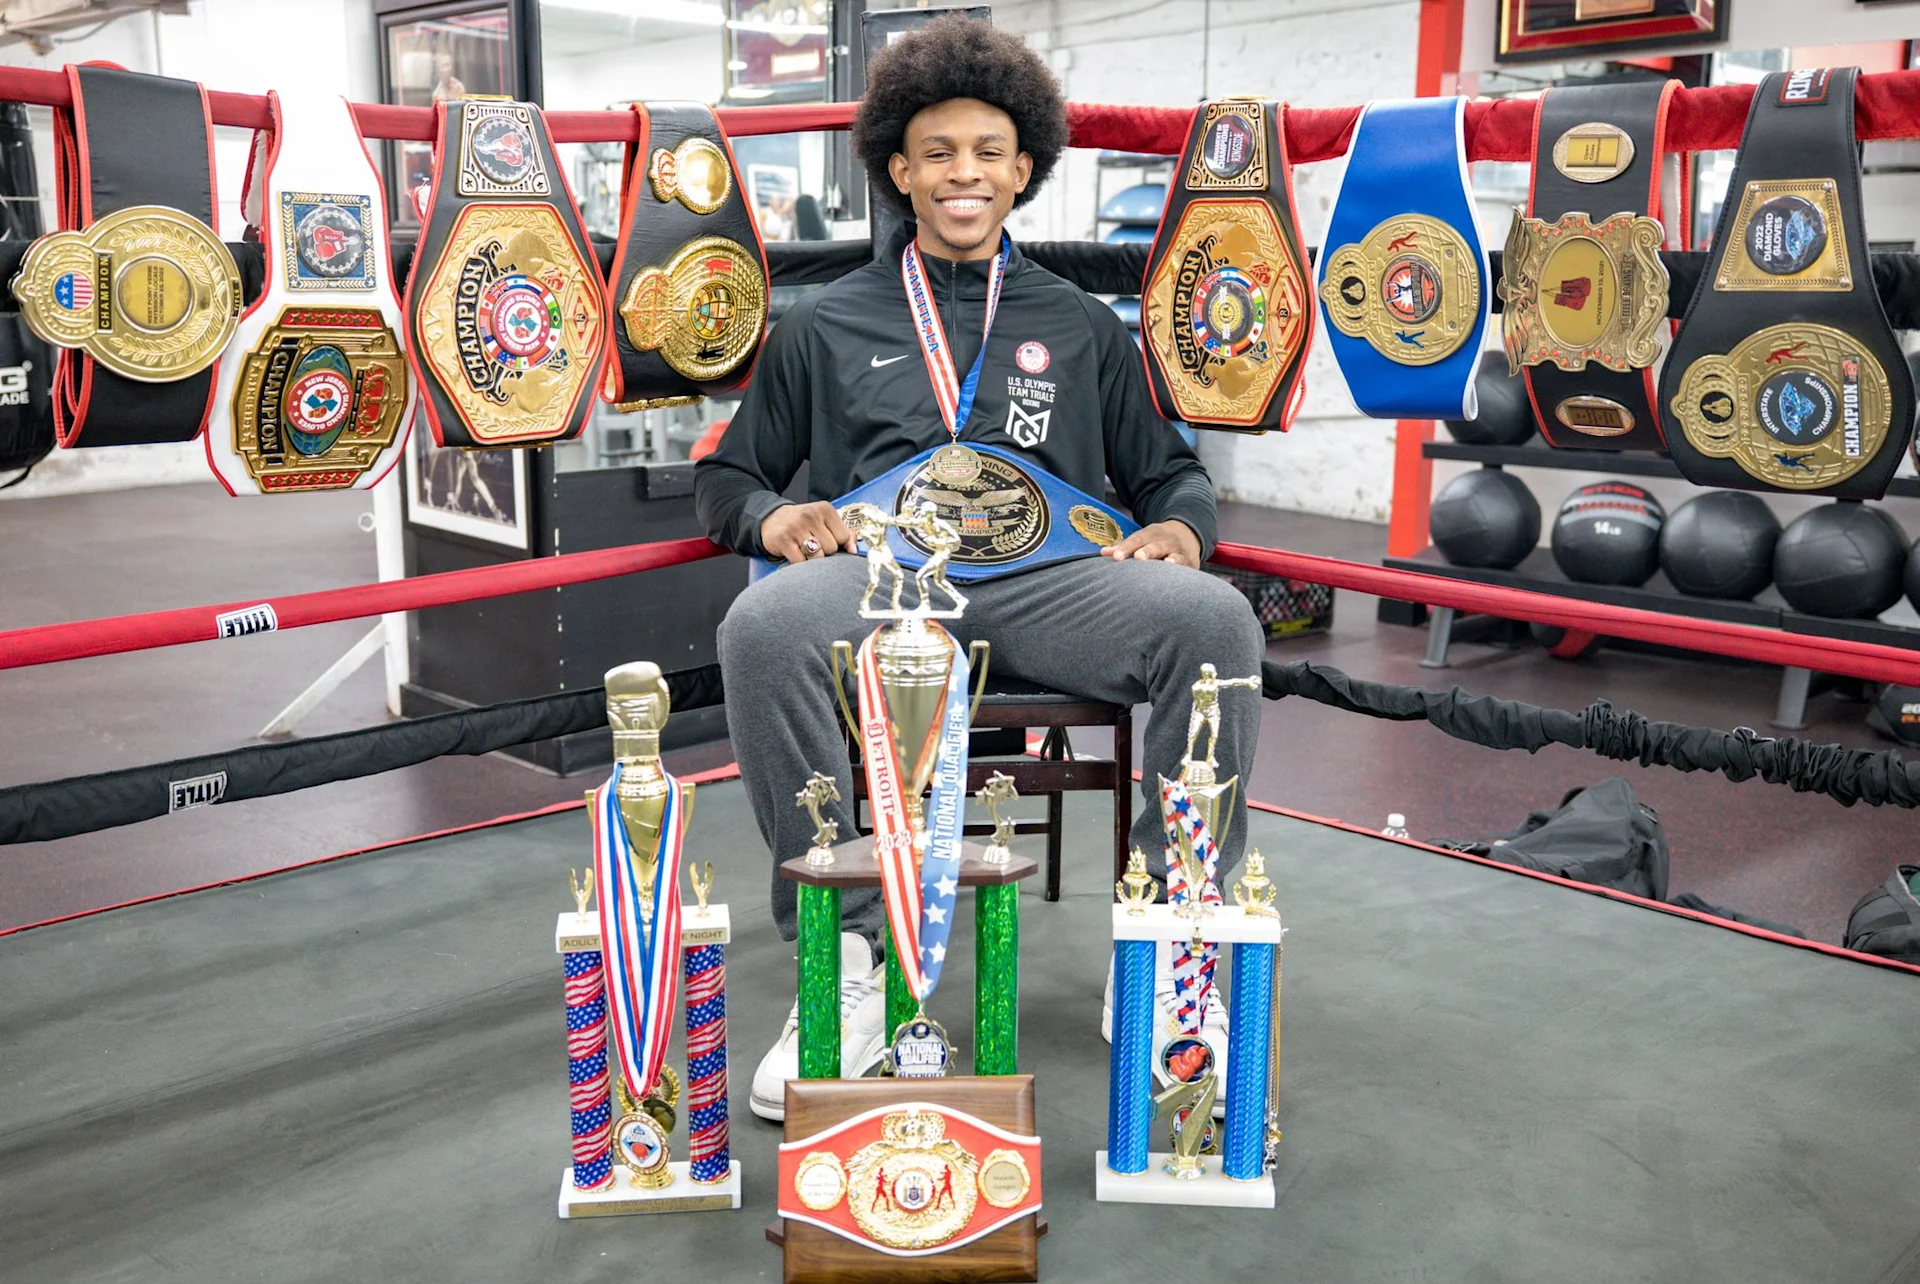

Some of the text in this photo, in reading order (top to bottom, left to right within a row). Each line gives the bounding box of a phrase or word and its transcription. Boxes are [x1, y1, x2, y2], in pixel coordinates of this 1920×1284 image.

[1218, 124, 1230, 169] CHAMPIONS
[1231, 133, 1244, 161] RINGSIDE
[1755, 225, 1764, 250] 2022
[1764, 212, 1774, 261] DIAMOND
[1773, 216, 1783, 256] GLOVES
[100, 258, 110, 328] CHAMPION
[1174, 254, 1201, 364] CHAMPION
[459, 262, 488, 385] CHAMPION
[926, 333, 939, 353] LA
[1007, 376, 1056, 393] U.S. OLYMPIC
[1007, 386, 1055, 403] TEAM TRIALS
[261, 351, 290, 450] CHAMPION
[298, 375, 349, 430] NEW JERSEY DIAMOND GLOVES
[1022, 398, 1040, 408] BOXING
[1761, 388, 1780, 434] INTERSTATE
[1804, 377, 1833, 435] CHAMPIONSHIPS
[1843, 384, 1860, 457] CHAMPION
[982, 460, 1014, 477] XING
[957, 527, 1001, 536] HAMPION
[225, 610, 271, 637] TITLE
[176, 779, 220, 808] TITLE
[932, 712, 965, 860] NATIONAL QUALIFIER
[876, 830, 913, 852] 2023
[563, 938, 598, 947] ADULT
[690, 930, 723, 941] NIGHT
[898, 1042, 944, 1056] NATIONAL
[900, 1053, 942, 1066] QUALIFIER
